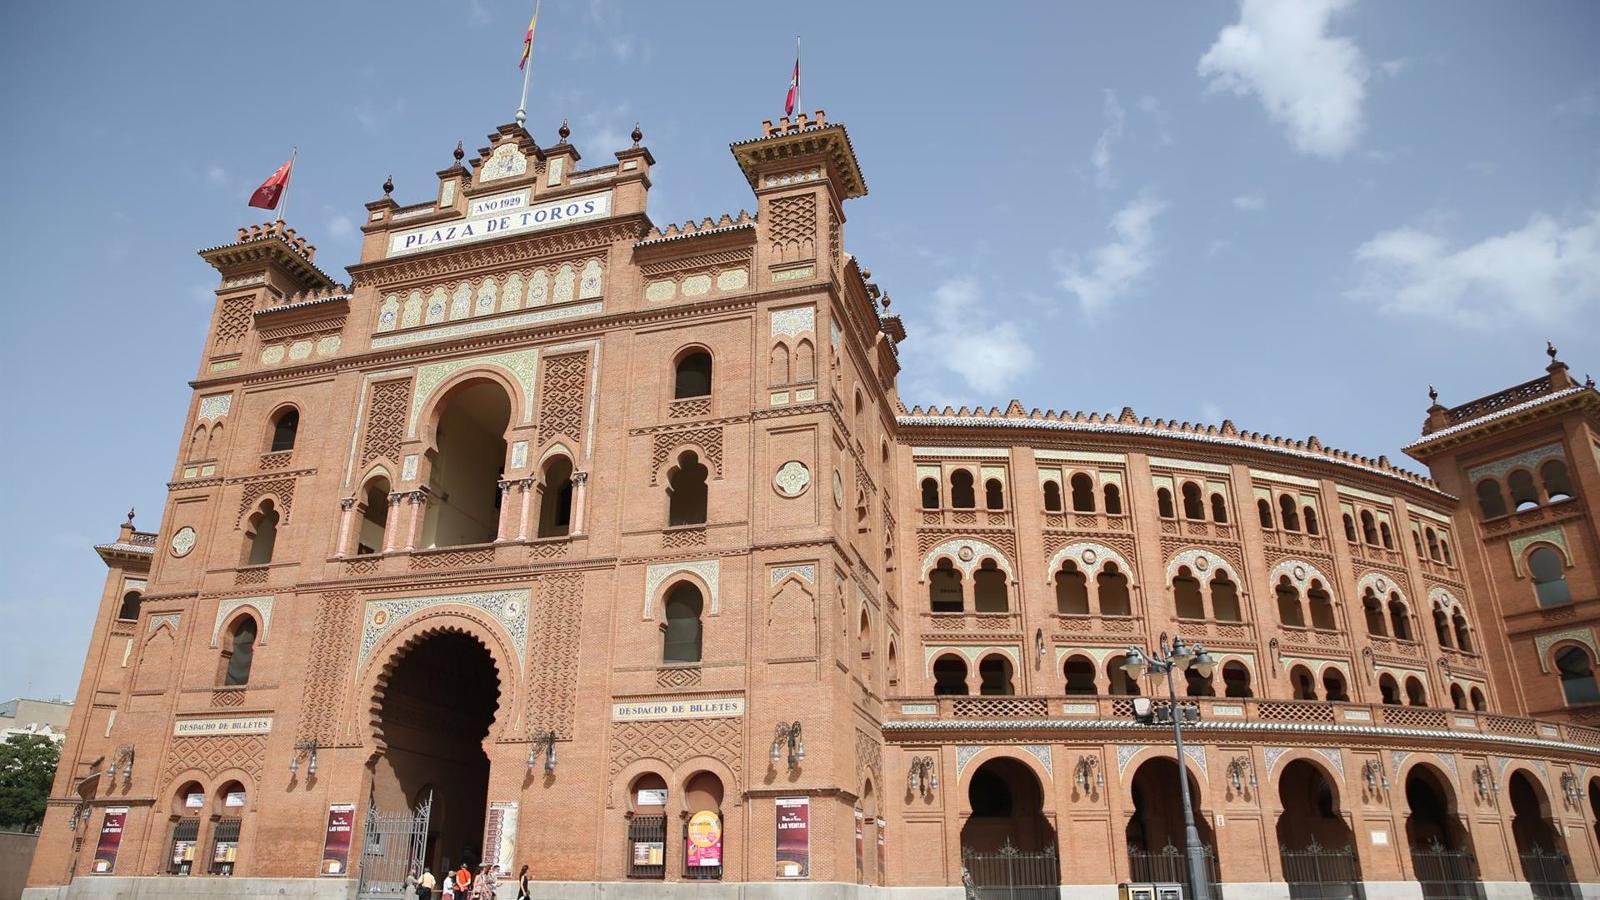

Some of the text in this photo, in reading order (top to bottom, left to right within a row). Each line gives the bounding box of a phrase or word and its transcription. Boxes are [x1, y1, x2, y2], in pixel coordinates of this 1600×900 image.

[475, 195, 521, 213] AÑO 1929
[405, 201, 595, 248] PLAZA DE TOROS
[619, 702, 738, 715] DESPACHO DE BILLETES
[179, 721, 268, 731] DESPACHO DE BILLETES
